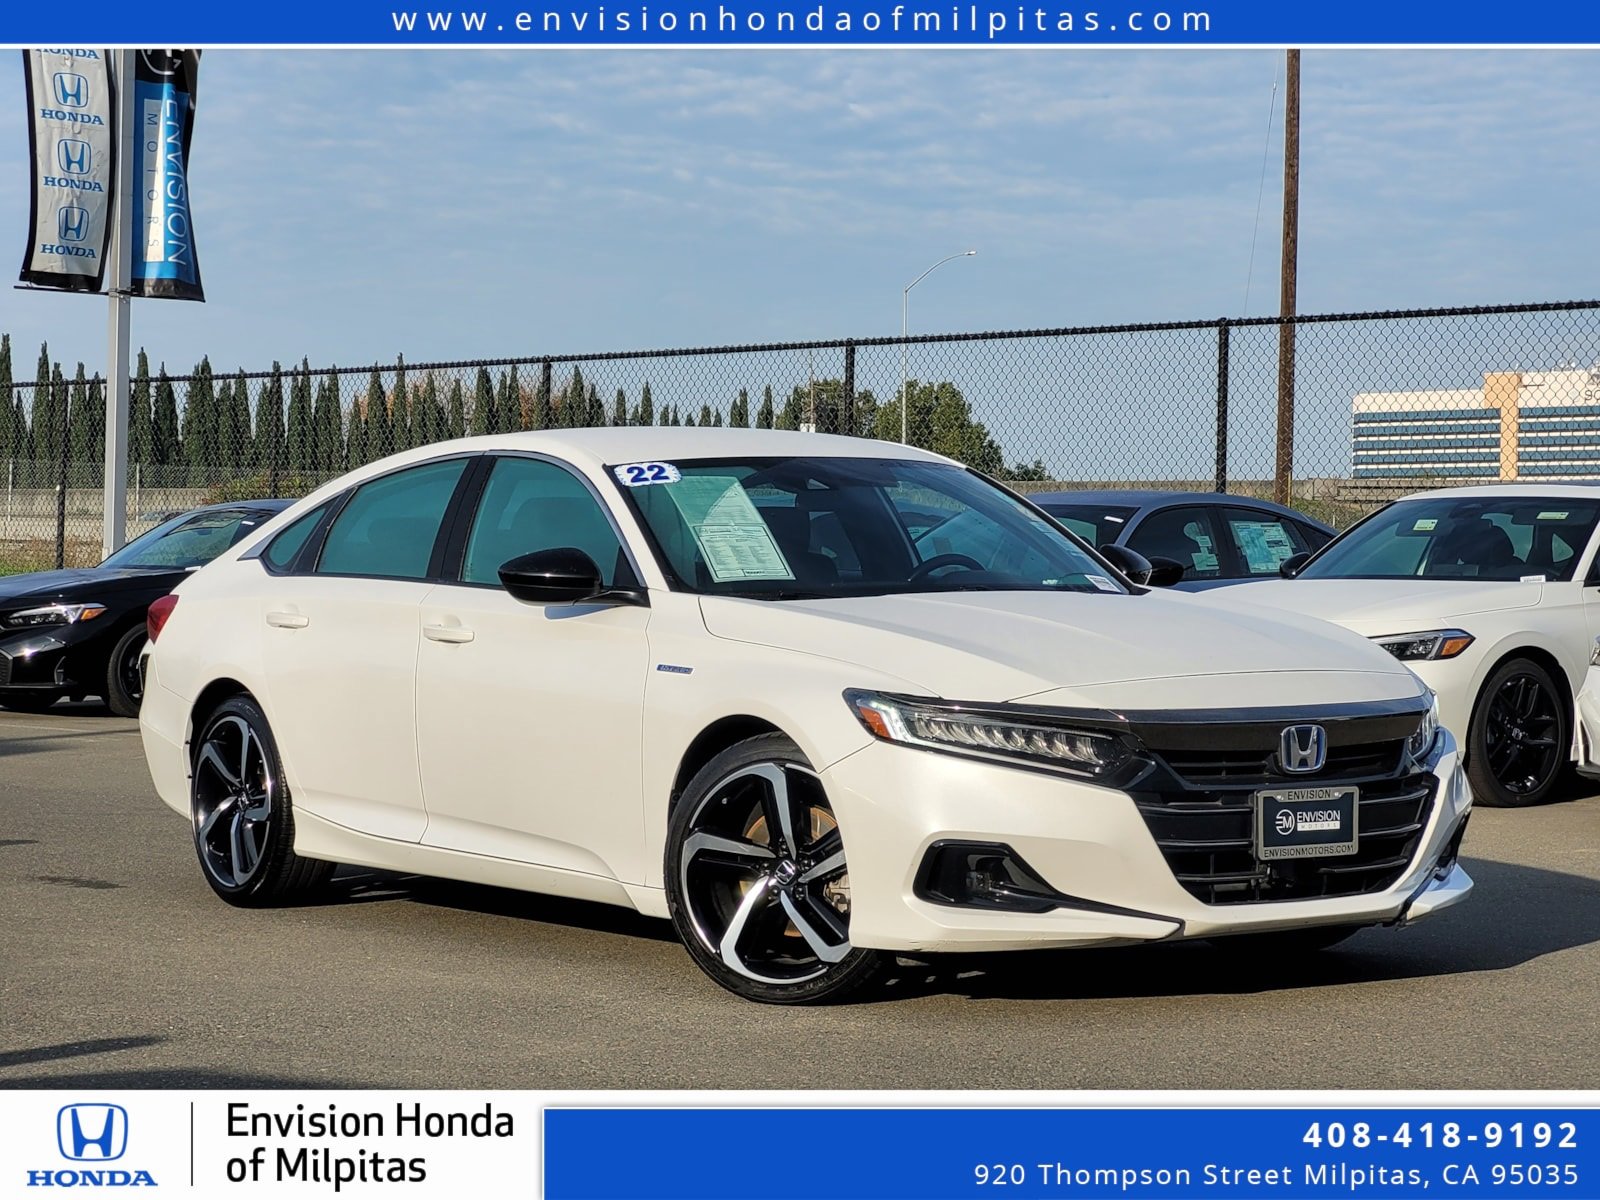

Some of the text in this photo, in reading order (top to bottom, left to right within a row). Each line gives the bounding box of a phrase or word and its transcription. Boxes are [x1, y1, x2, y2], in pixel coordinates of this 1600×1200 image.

[40, 108, 104, 126] HONDA
[43, 176, 104, 192] HONDA
[146, 112, 160, 248] MOTORS
[166, 99, 187, 266] ENVISION
[40, 244, 97, 259] HONDA
[626, 464, 670, 483] 22
[1287, 789, 1331, 800] ENVISION
[1296, 810, 1341, 822] ENVISION
[1264, 844, 1354, 858] ENVISIONMOTORS.COM
